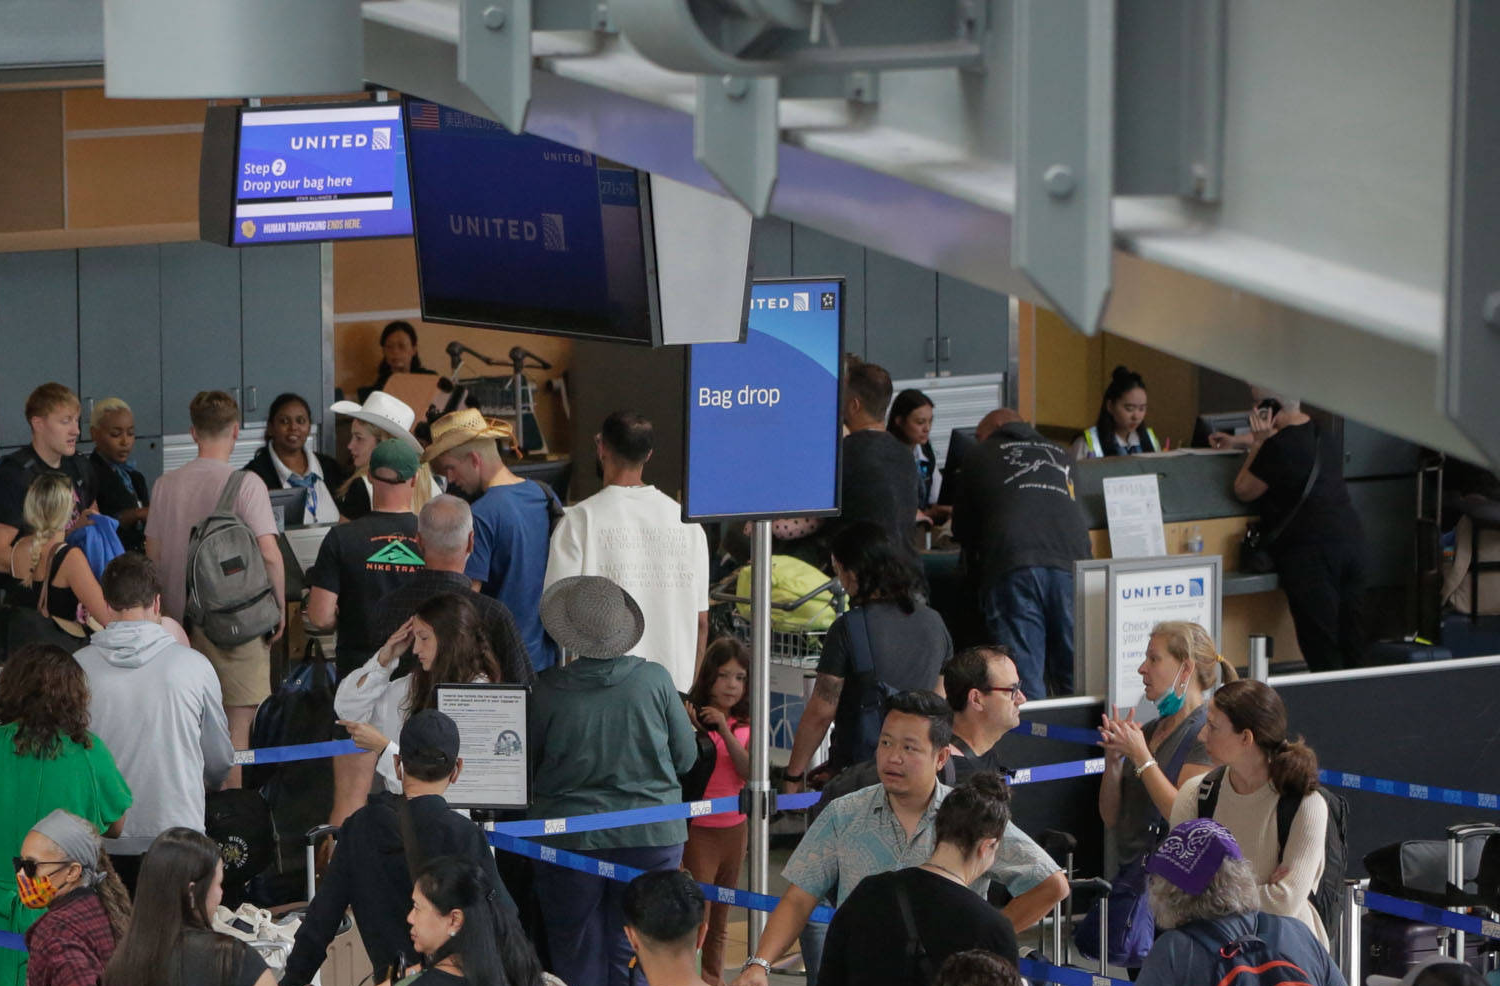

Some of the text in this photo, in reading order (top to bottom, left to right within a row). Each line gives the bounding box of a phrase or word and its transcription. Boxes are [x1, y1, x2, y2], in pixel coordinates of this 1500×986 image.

[291, 134, 368, 150] UNITED
[544, 151, 581, 163] UNITED
[244, 160, 285, 177] Step 2
[243, 176, 353, 193] Drop your bag here
[263, 223, 286, 234] HUMAN
[287, 221, 327, 233] TRAFFICKING
[449, 213, 537, 241] UNITED
[750, 298, 790, 310] ITED
[699, 385, 781, 409] Bag drop
[366, 563, 393, 572] NIKE
[1122, 584, 1185, 600] UNITED
[1123, 621, 1148, 632] Check
